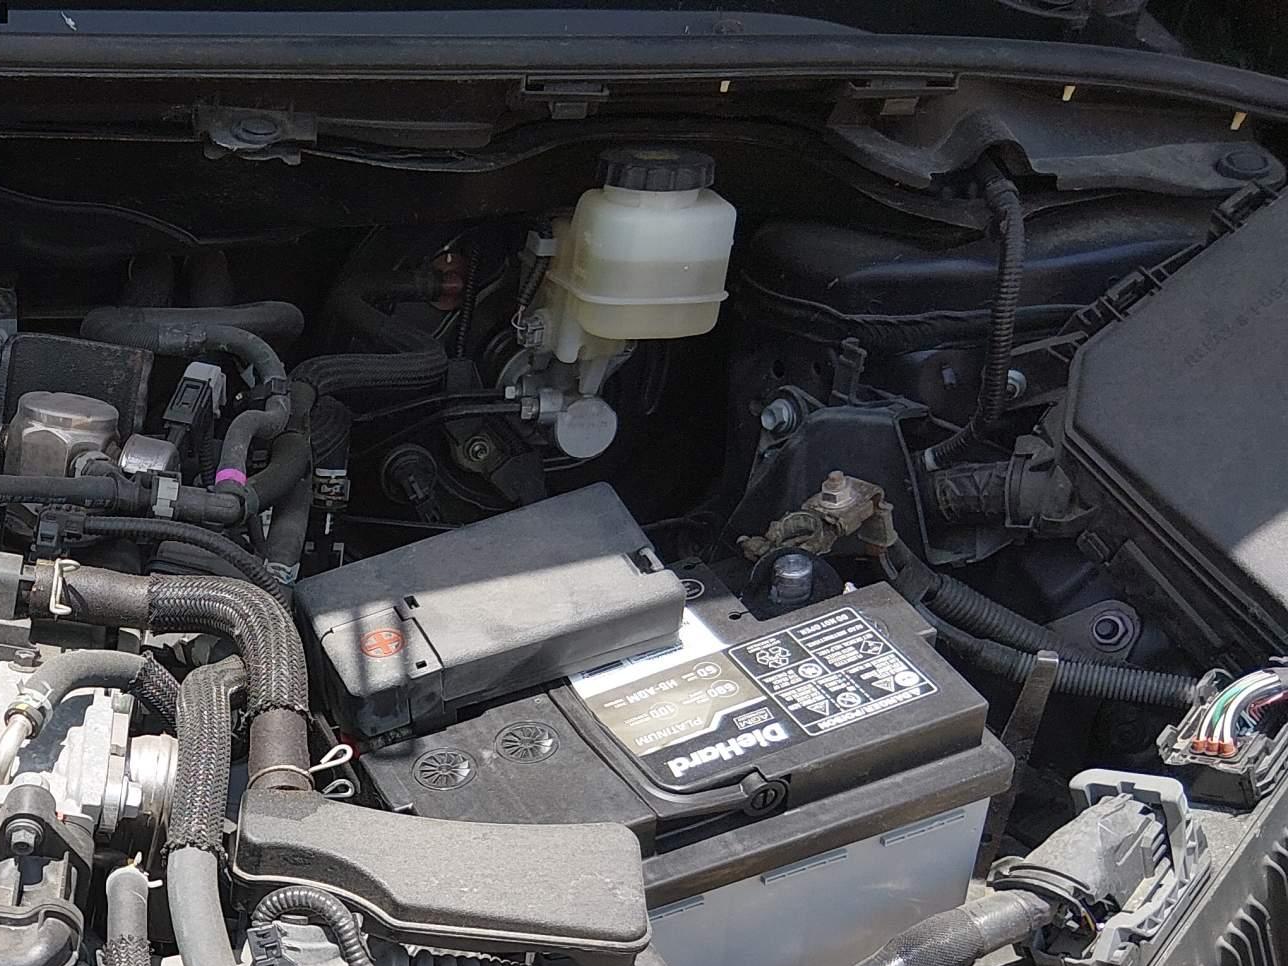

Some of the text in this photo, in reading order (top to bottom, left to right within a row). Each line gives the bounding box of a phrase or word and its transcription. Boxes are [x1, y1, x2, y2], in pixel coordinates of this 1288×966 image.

[820, 618, 837, 627] NOT
[697, 664, 719, 677] 60
[652, 702, 675, 718] 100
[738, 712, 769, 727] AGM
[634, 716, 702, 746] PLATINUM
[666, 722, 789, 778] DieHard
